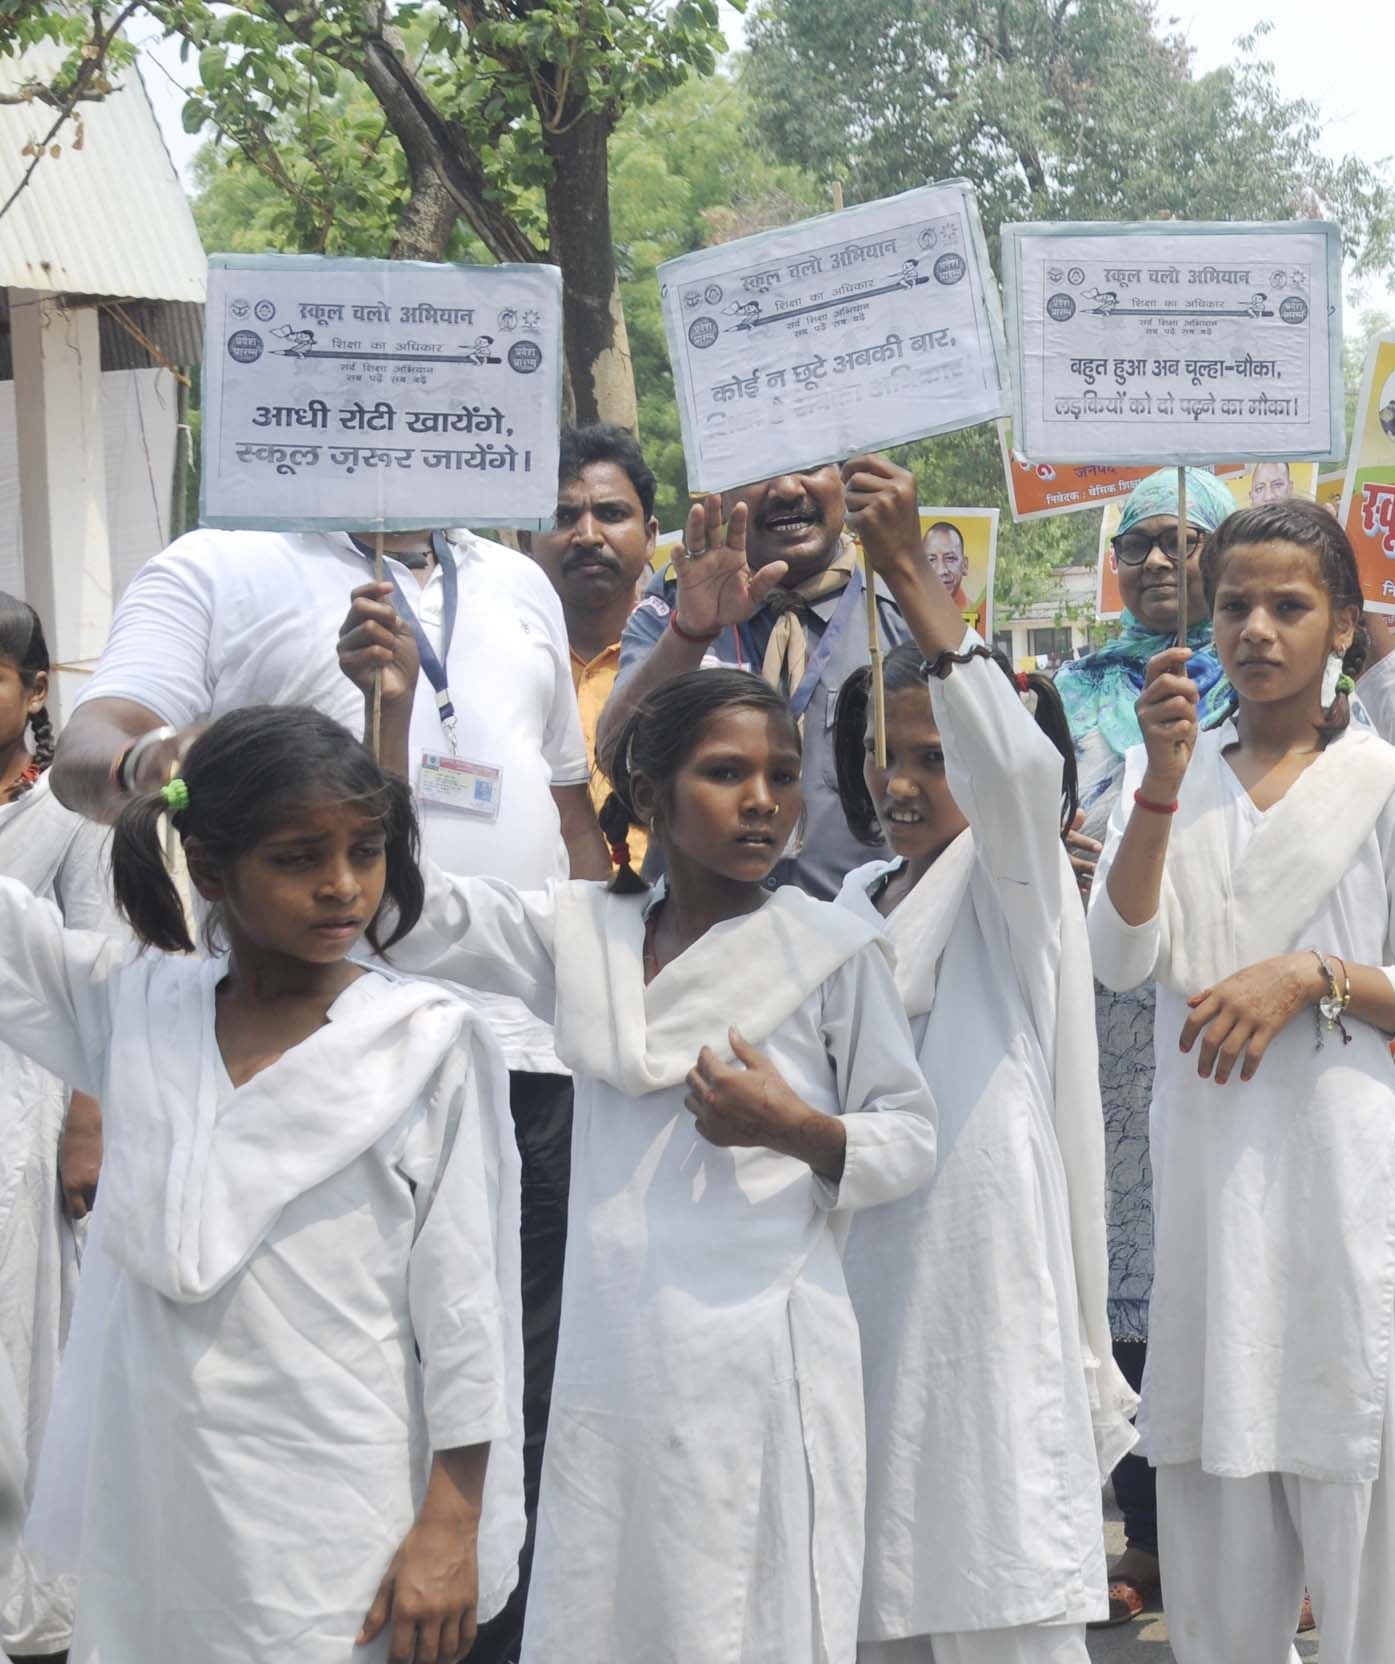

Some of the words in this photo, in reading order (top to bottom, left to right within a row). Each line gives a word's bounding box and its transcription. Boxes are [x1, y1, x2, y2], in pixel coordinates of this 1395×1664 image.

[740, 268, 782, 293] स्कूल
[787, 255, 823, 279] चलो
[830, 238, 897, 270] अभियान
[1104, 268, 1142, 288] स्कूल
[1147, 266, 1181, 284] चलो
[1188, 266, 1252, 285] अभियान
[298, 303, 345, 327] स्कूल
[351, 301, 392, 322] चलो
[400, 303, 475, 327] अभियान
[332, 337, 361, 349] शिक्षा
[370, 340, 387, 350] का
[395, 340, 443, 352] अधिकार
[711, 368, 760, 403] कोई
[766, 368, 786, 389] न
[792, 354, 827, 391] छूटे
[833, 333, 904, 375] अबकी
[1070, 358, 1108, 385] बहुत
[1113, 358, 1147, 386] हुआ
[1129, 391, 1152, 415] को
[1157, 392, 1175, 415] दो
[1221, 399, 1243, 416] का
[252, 400, 331, 429] आधी
[339, 401, 397, 430] रोटी
[405, 406, 513, 436] खायेंगे,
[235, 442, 323, 475] स्कूल
[328, 446, 416, 474] ज़रूर
